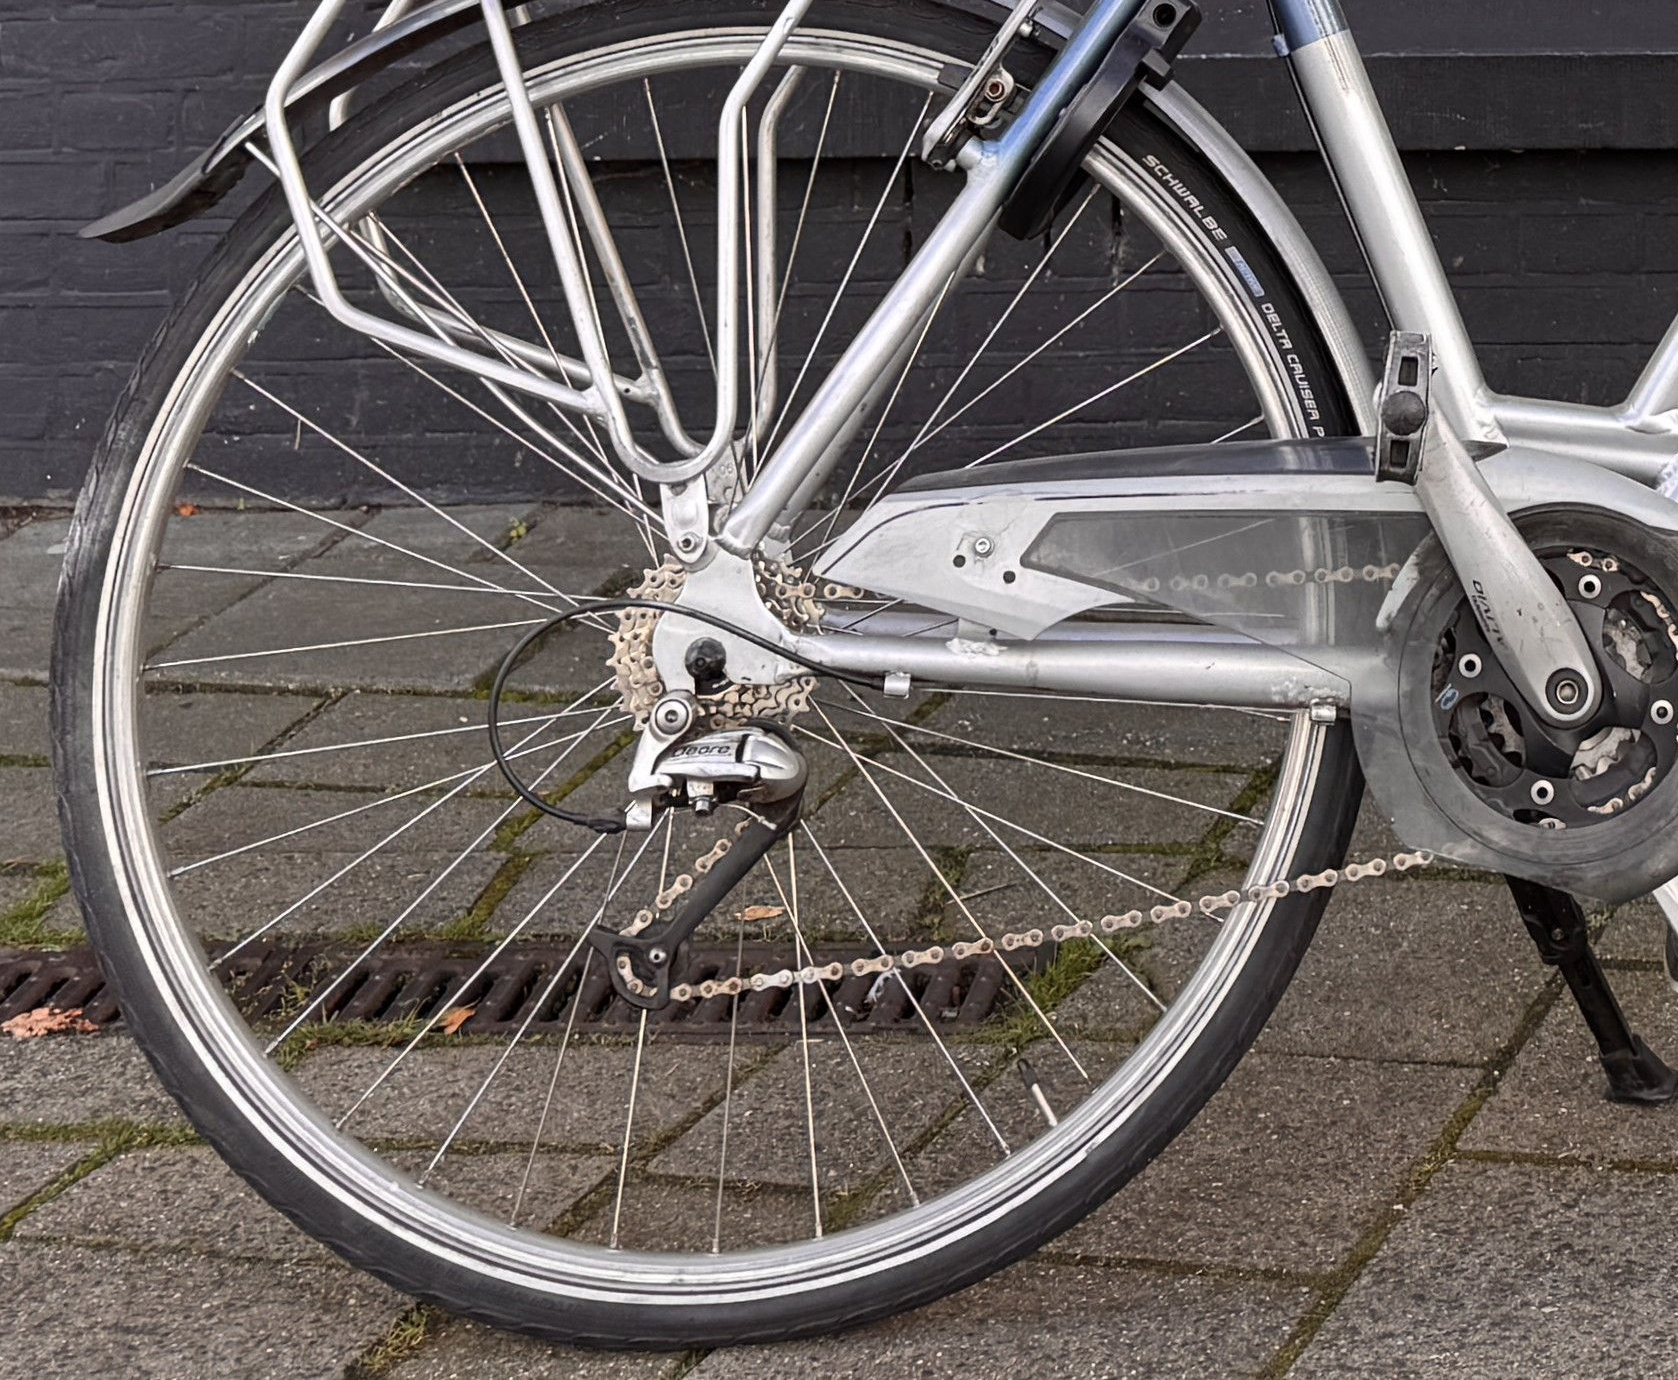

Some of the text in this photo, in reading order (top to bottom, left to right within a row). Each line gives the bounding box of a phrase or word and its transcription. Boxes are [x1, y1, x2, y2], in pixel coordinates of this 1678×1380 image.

[1141, 152, 1229, 243] SCHWALBE
[1261, 301, 1293, 351] DELTA
[1285, 350, 1321, 425] CRUISER
